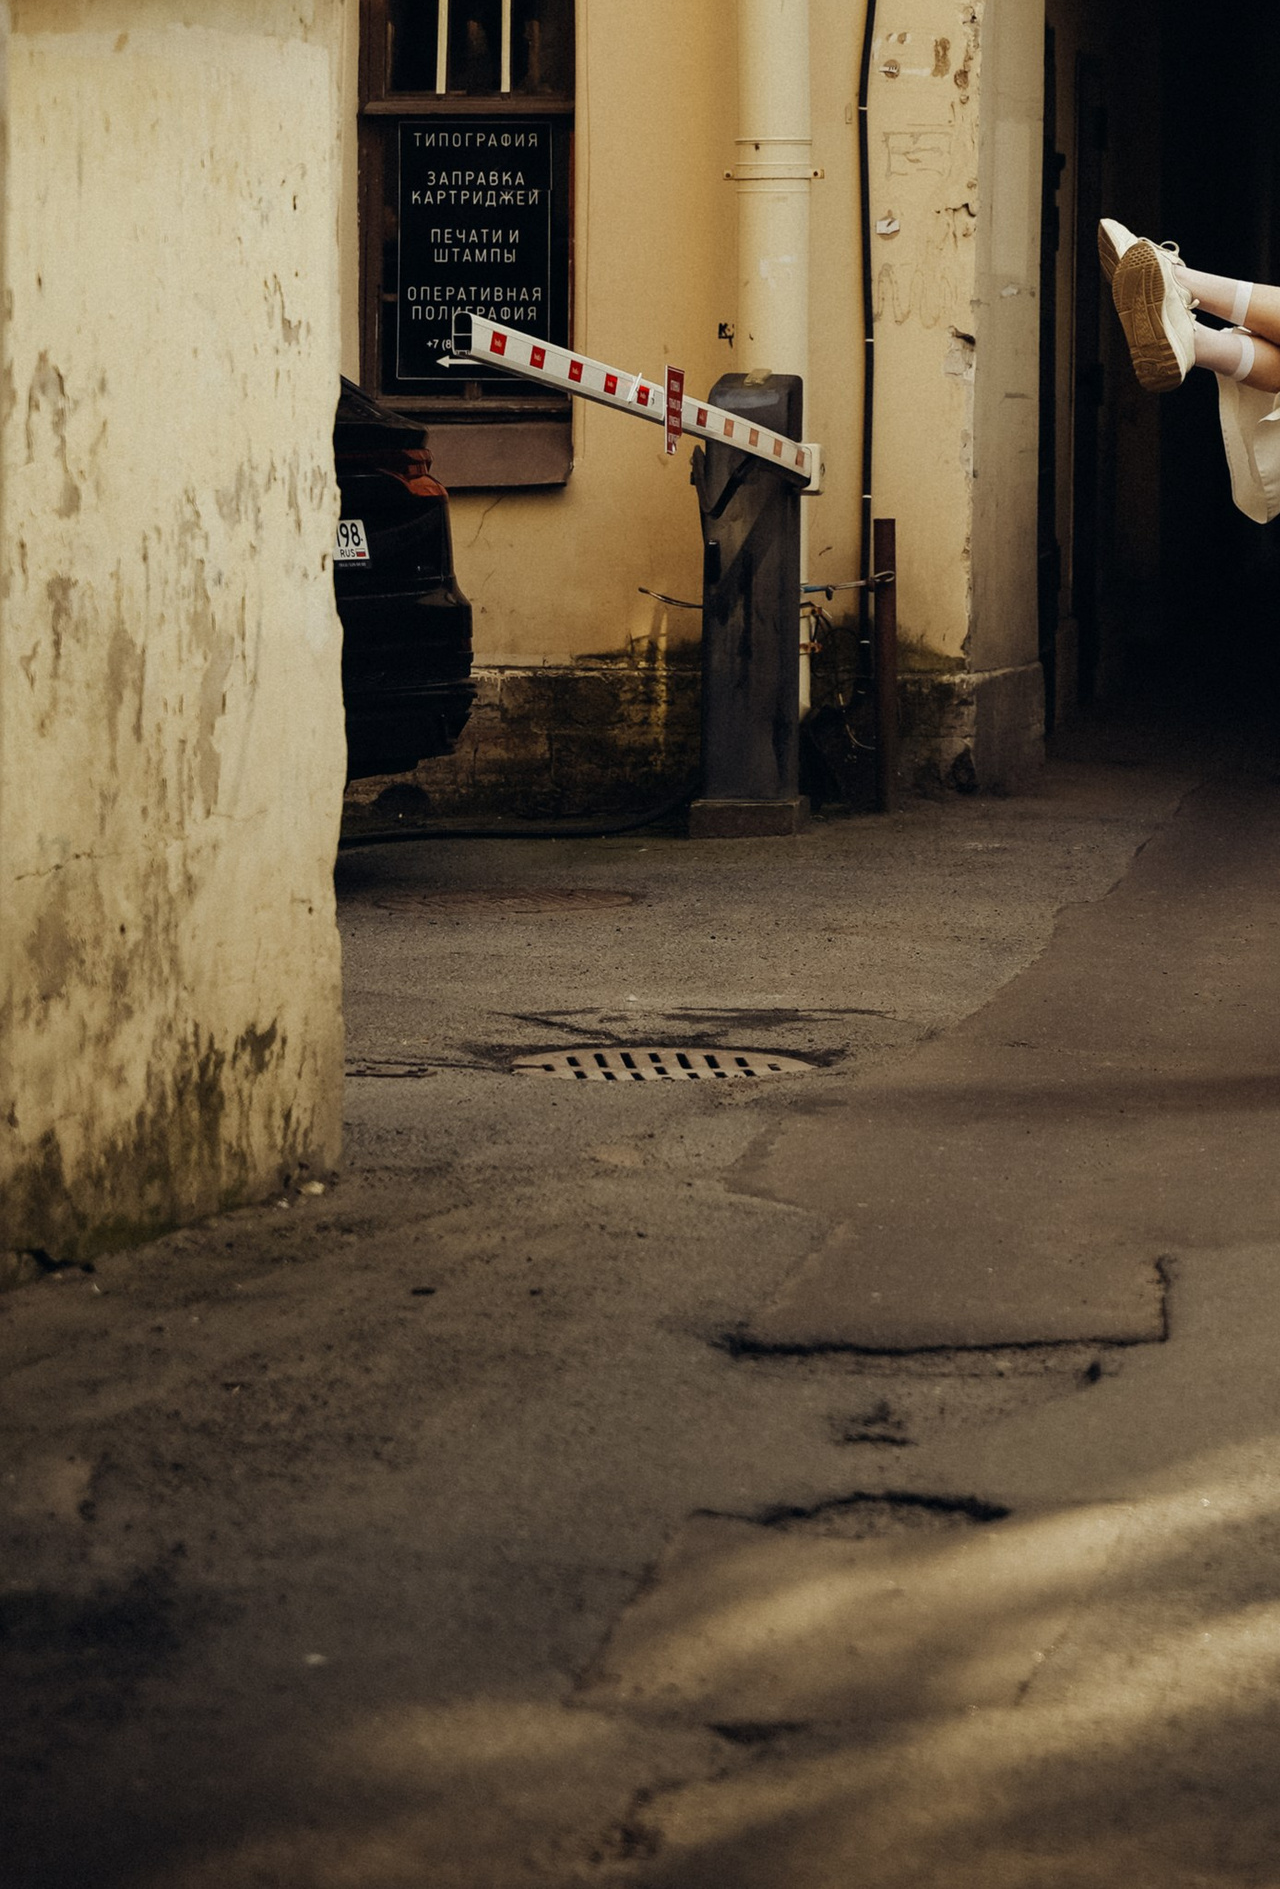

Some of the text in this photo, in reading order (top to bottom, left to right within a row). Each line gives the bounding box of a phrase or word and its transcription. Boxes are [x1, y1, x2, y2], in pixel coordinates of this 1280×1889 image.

[413, 132, 538, 148] ТИПОГРАФИЯ
[427, 171, 525, 186] ЗАПРАВКА
[411, 189, 539, 207] КАРТРИДЖЕЙ
[431, 228, 519, 244] ПЕЧАТИ И
[434, 248, 516, 263] ШТАМПЫ
[407, 286, 541, 302] ОПЕРАТИВНАЯ
[426, 338, 439, 349] +7
[339, 548, 356, 558] RUS
